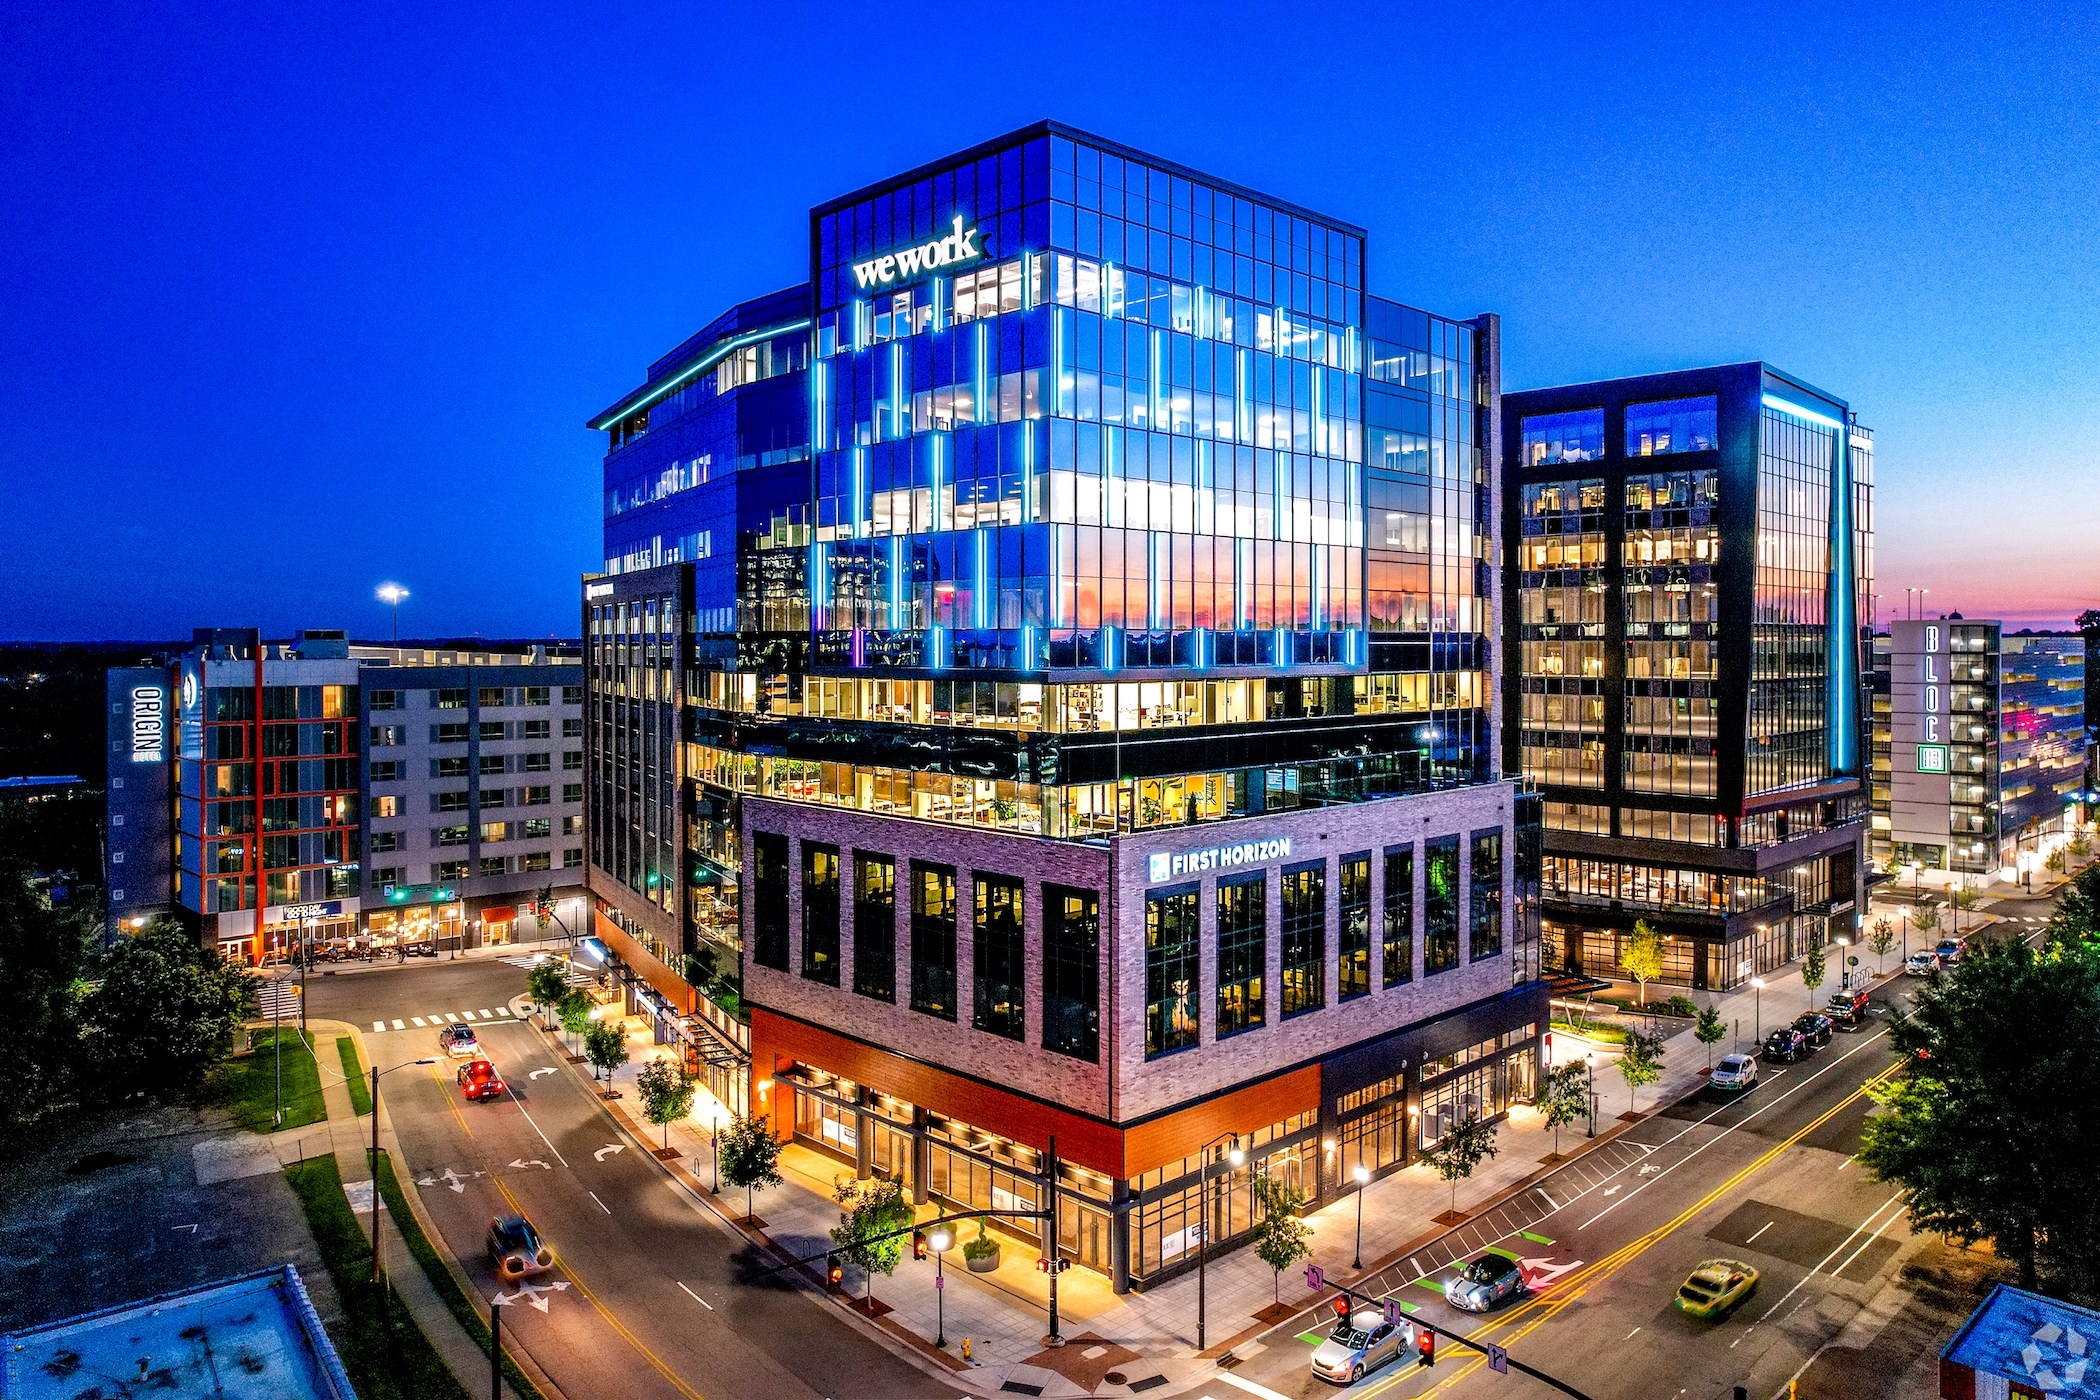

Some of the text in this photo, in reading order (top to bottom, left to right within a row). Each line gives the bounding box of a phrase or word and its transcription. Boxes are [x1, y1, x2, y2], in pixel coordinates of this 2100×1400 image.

[853, 215, 979, 289] wework
[1926, 626, 1939, 743] BLOC
[133, 687, 163, 751] ORIGIN
[1172, 838, 1291, 875] FIRST HORIZON
[287, 905, 308, 914] GOOD
